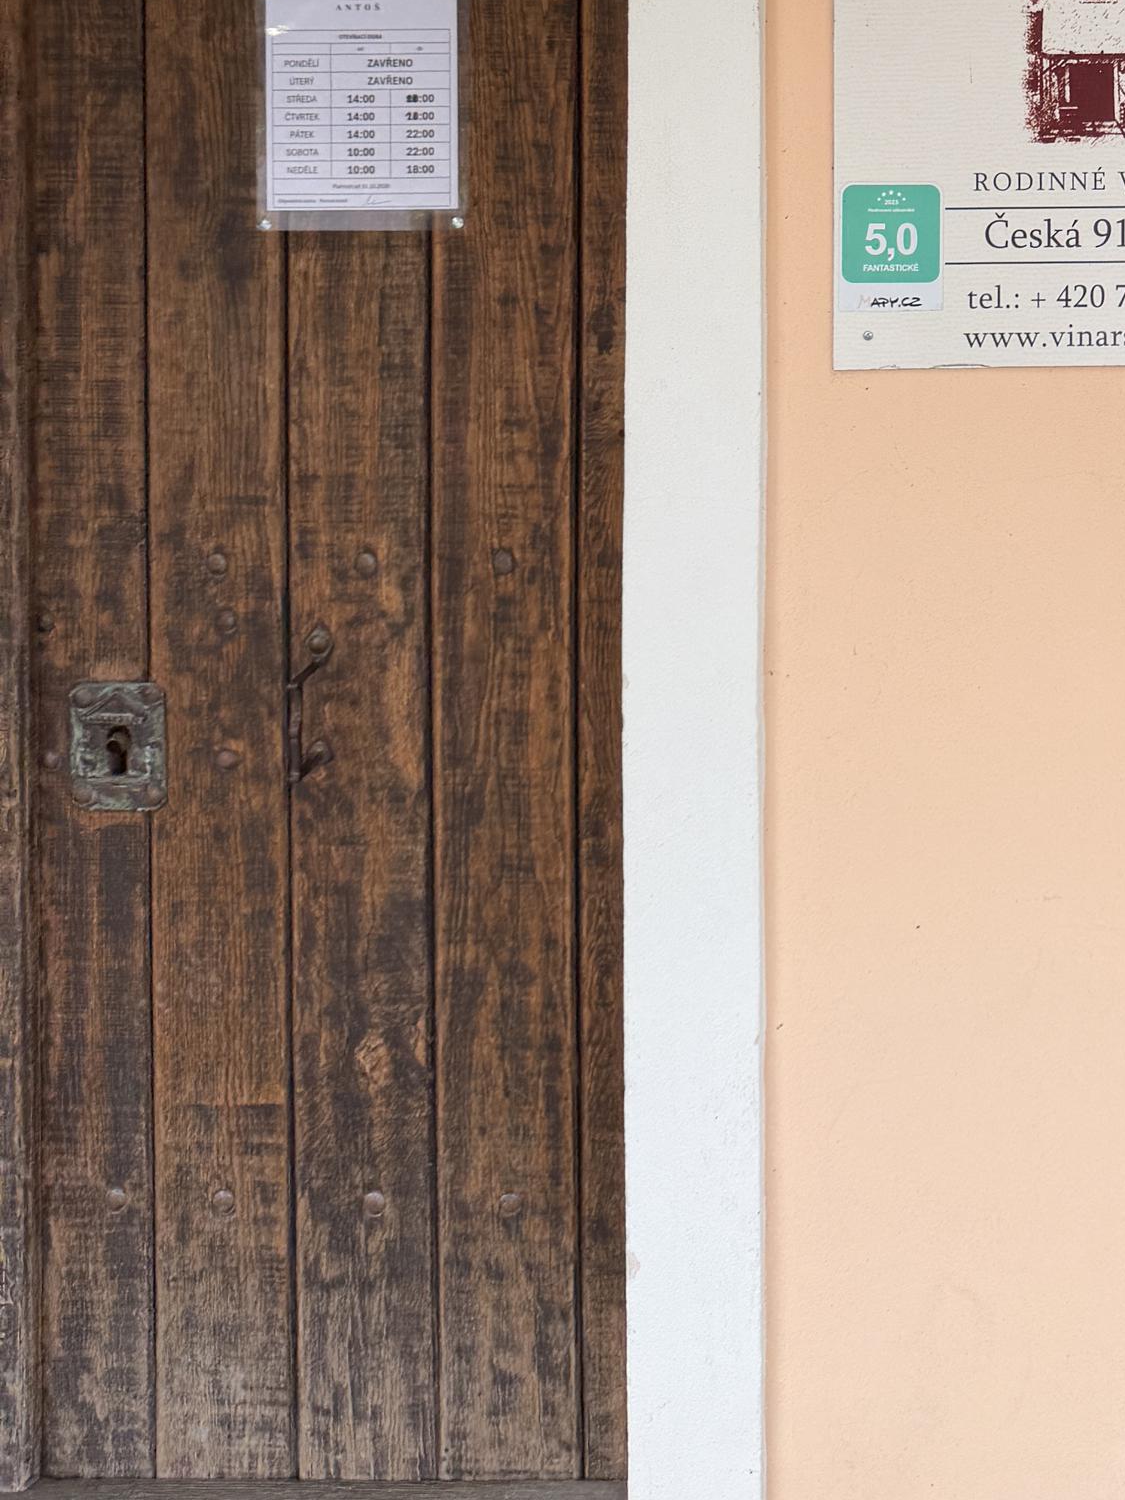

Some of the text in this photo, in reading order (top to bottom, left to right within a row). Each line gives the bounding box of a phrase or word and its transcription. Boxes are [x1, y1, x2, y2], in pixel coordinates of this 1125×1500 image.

[335, 2, 381, 12] ANTOŠ
[283, 57, 414, 68] PONDĚLÍ ZAVŘENO
[288, 75, 414, 86] ÚTERÝ ZAVŘENO
[286, 93, 318, 104] STŘEDA
[346, 94, 376, 104] 14:00
[284, 111, 320, 122] ČTVRTEK
[346, 112, 376, 122] 14:00
[289, 128, 435, 140] PÁTEK 14:00 22:00
[286, 146, 435, 157] SOBOTA 10:00 22:00
[286, 164, 435, 175] NEDĚLE 10:00 18:00
[973, 167, 1106, 192] RODINNÉ
[984, 212, 1082, 249] Česká
[864, 222, 918, 262] 5,0
[863, 262, 920, 272] FANTASTICKÉ
[967, 285, 1021, 310] tel.:
[1030, 291, 1047, 309] +
[1056, 284, 1106, 310] 420
